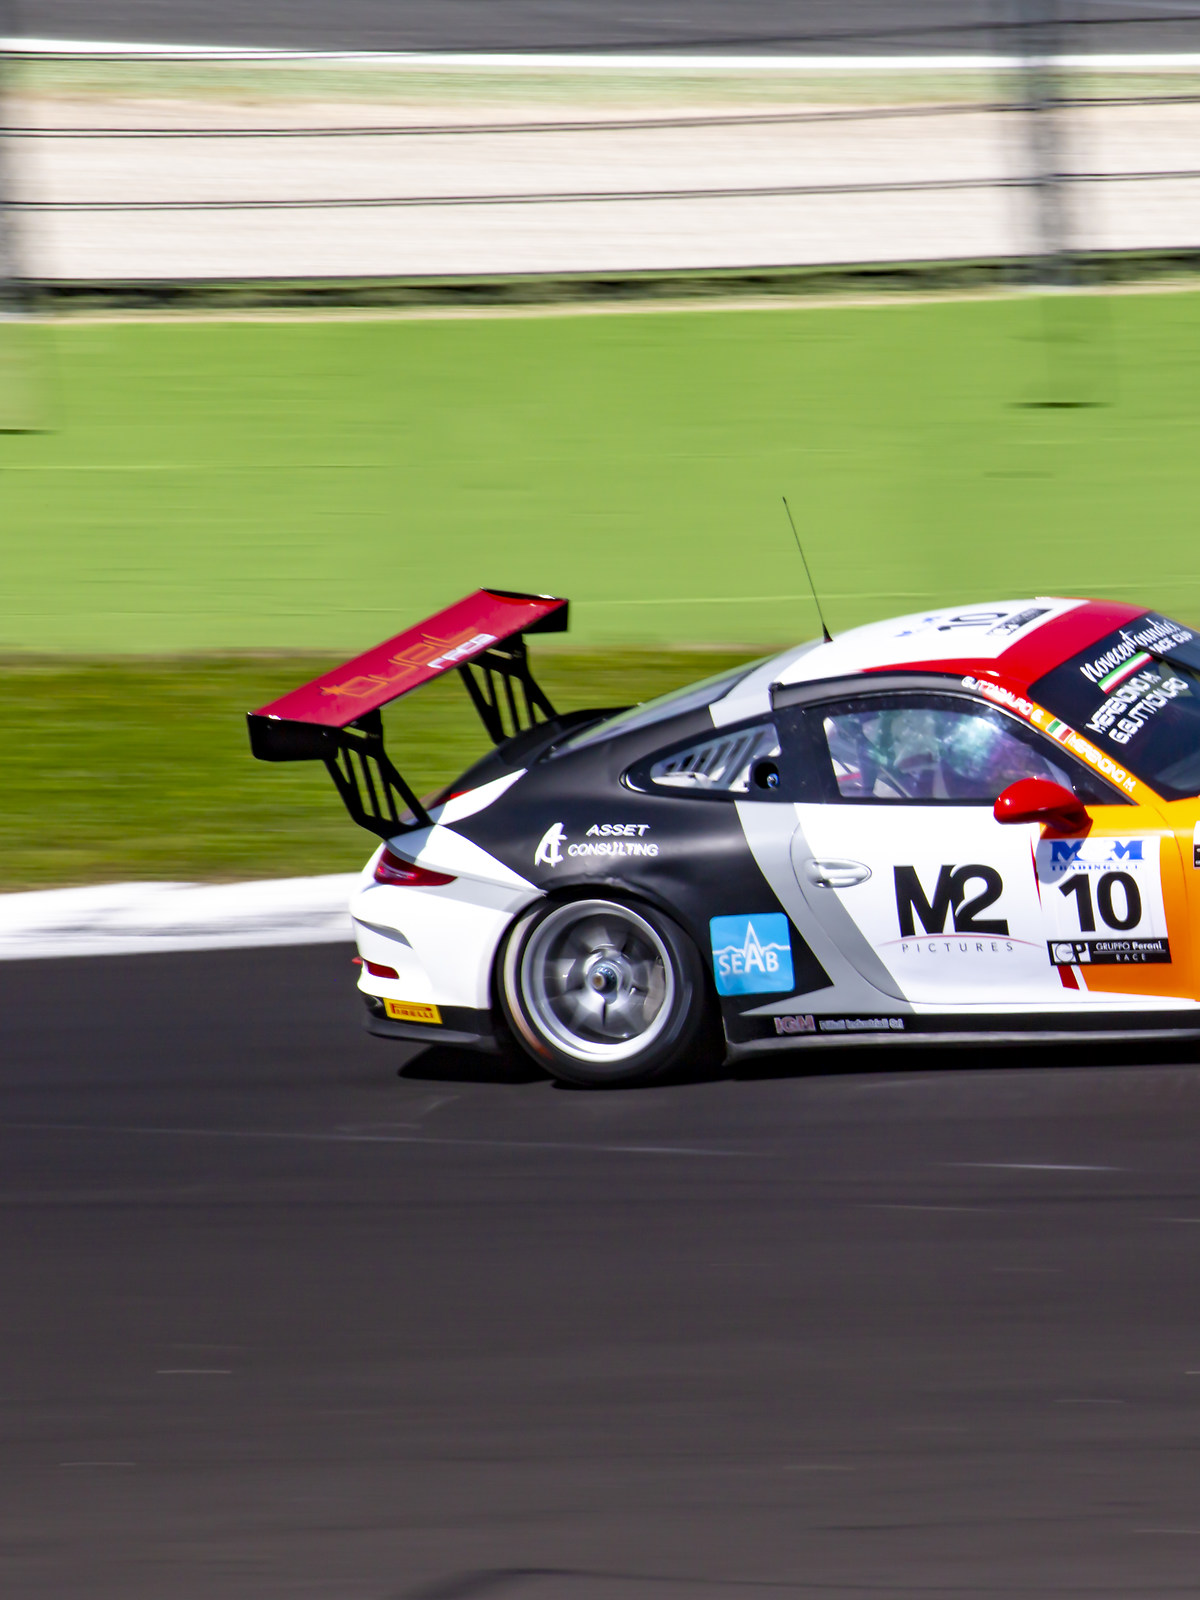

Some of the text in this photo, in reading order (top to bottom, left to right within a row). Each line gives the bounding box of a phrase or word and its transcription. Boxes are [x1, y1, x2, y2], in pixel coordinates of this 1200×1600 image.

[585, 823, 651, 837] ASSET
[567, 841, 659, 857] CONSULTING
[893, 863, 1010, 938] M2
[1058, 871, 1142, 932] 10
[902, 942, 1014, 953] PICTURES
[1095, 942, 1131, 951] GRUPPO
[1132, 940, 1162, 951] Peroni
[718, 942, 779, 976] SEAB
[1115, 953, 1147, 961] RACE
[390, 1003, 435, 1019] PIRELLI
